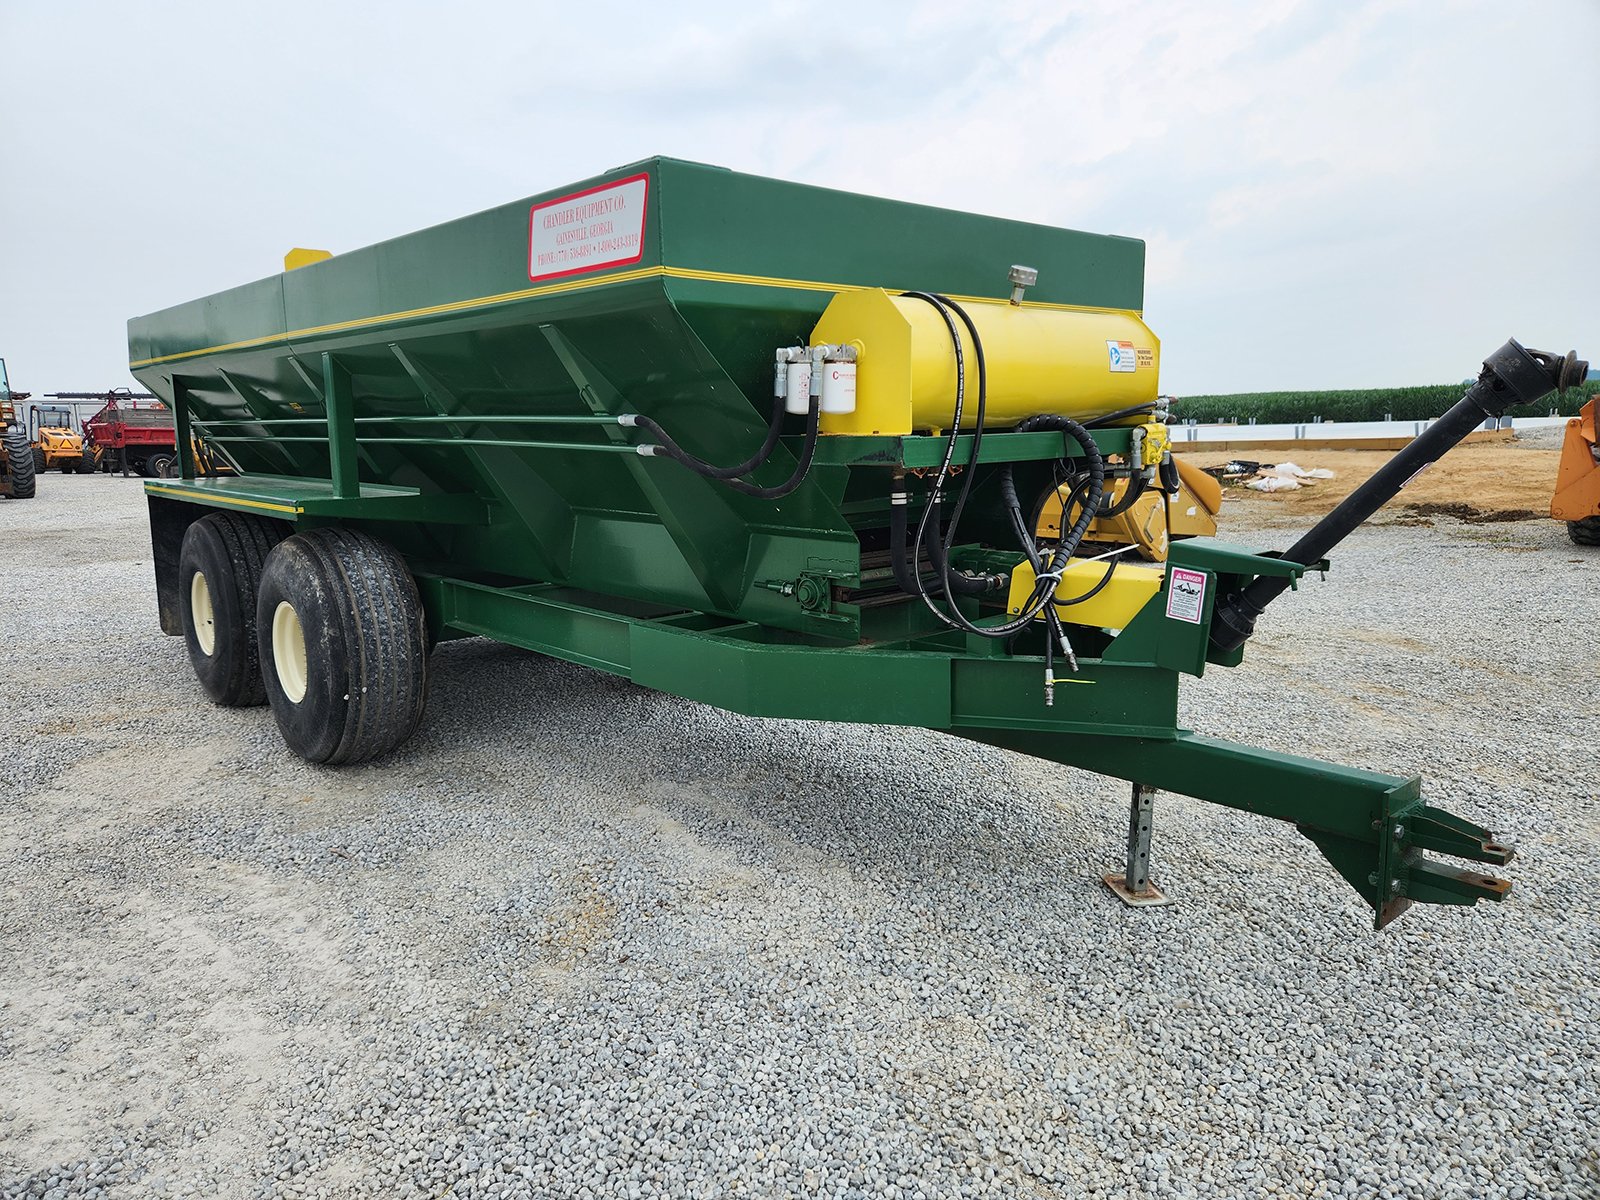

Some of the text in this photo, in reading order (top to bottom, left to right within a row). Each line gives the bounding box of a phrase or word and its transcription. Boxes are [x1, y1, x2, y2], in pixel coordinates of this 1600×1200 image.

[543, 194, 626, 229] CHANDLER EQUIPMENT CO.
[589, 220, 614, 239] GEORGIA
[1182, 574, 1202, 583] DANGER
